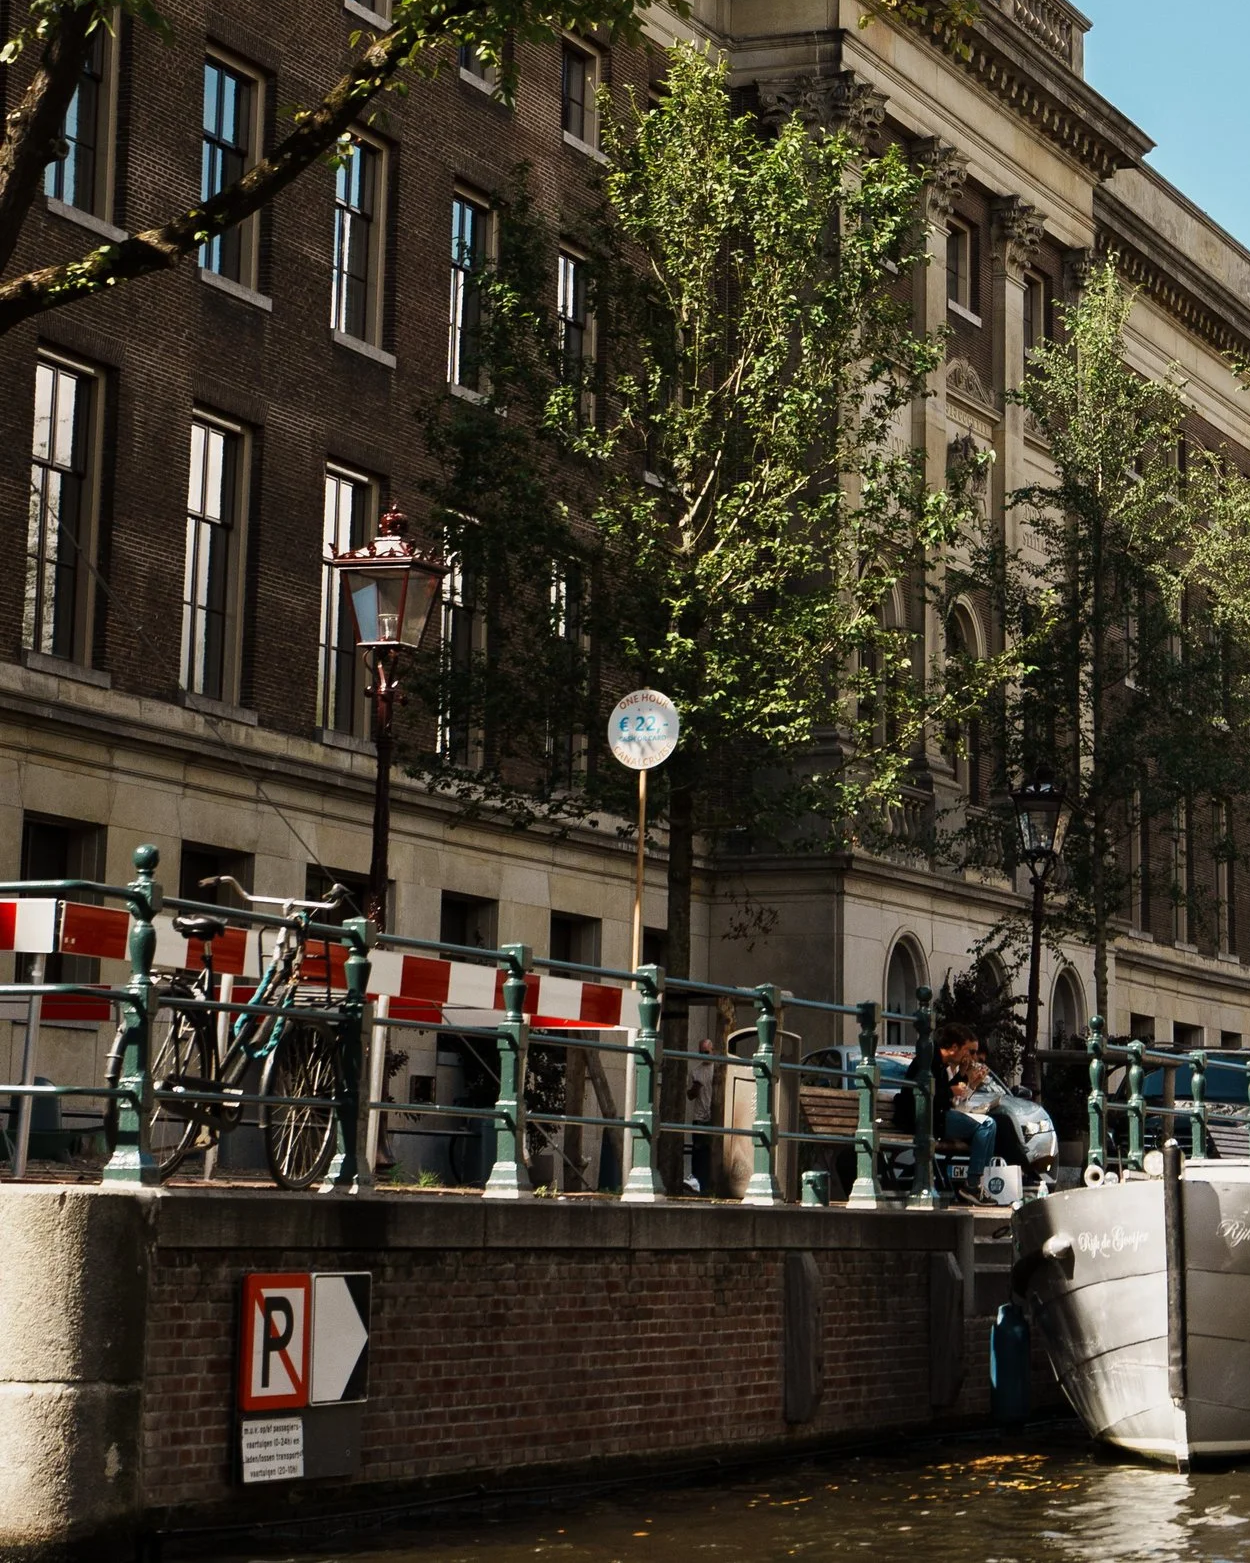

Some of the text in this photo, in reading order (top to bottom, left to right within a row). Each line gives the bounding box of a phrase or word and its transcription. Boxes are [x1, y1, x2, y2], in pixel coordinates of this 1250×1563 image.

[619, 693, 670, 710] ONE HOUR
[618, 716, 630, 732] €
[261, 1296, 294, 1388] P
